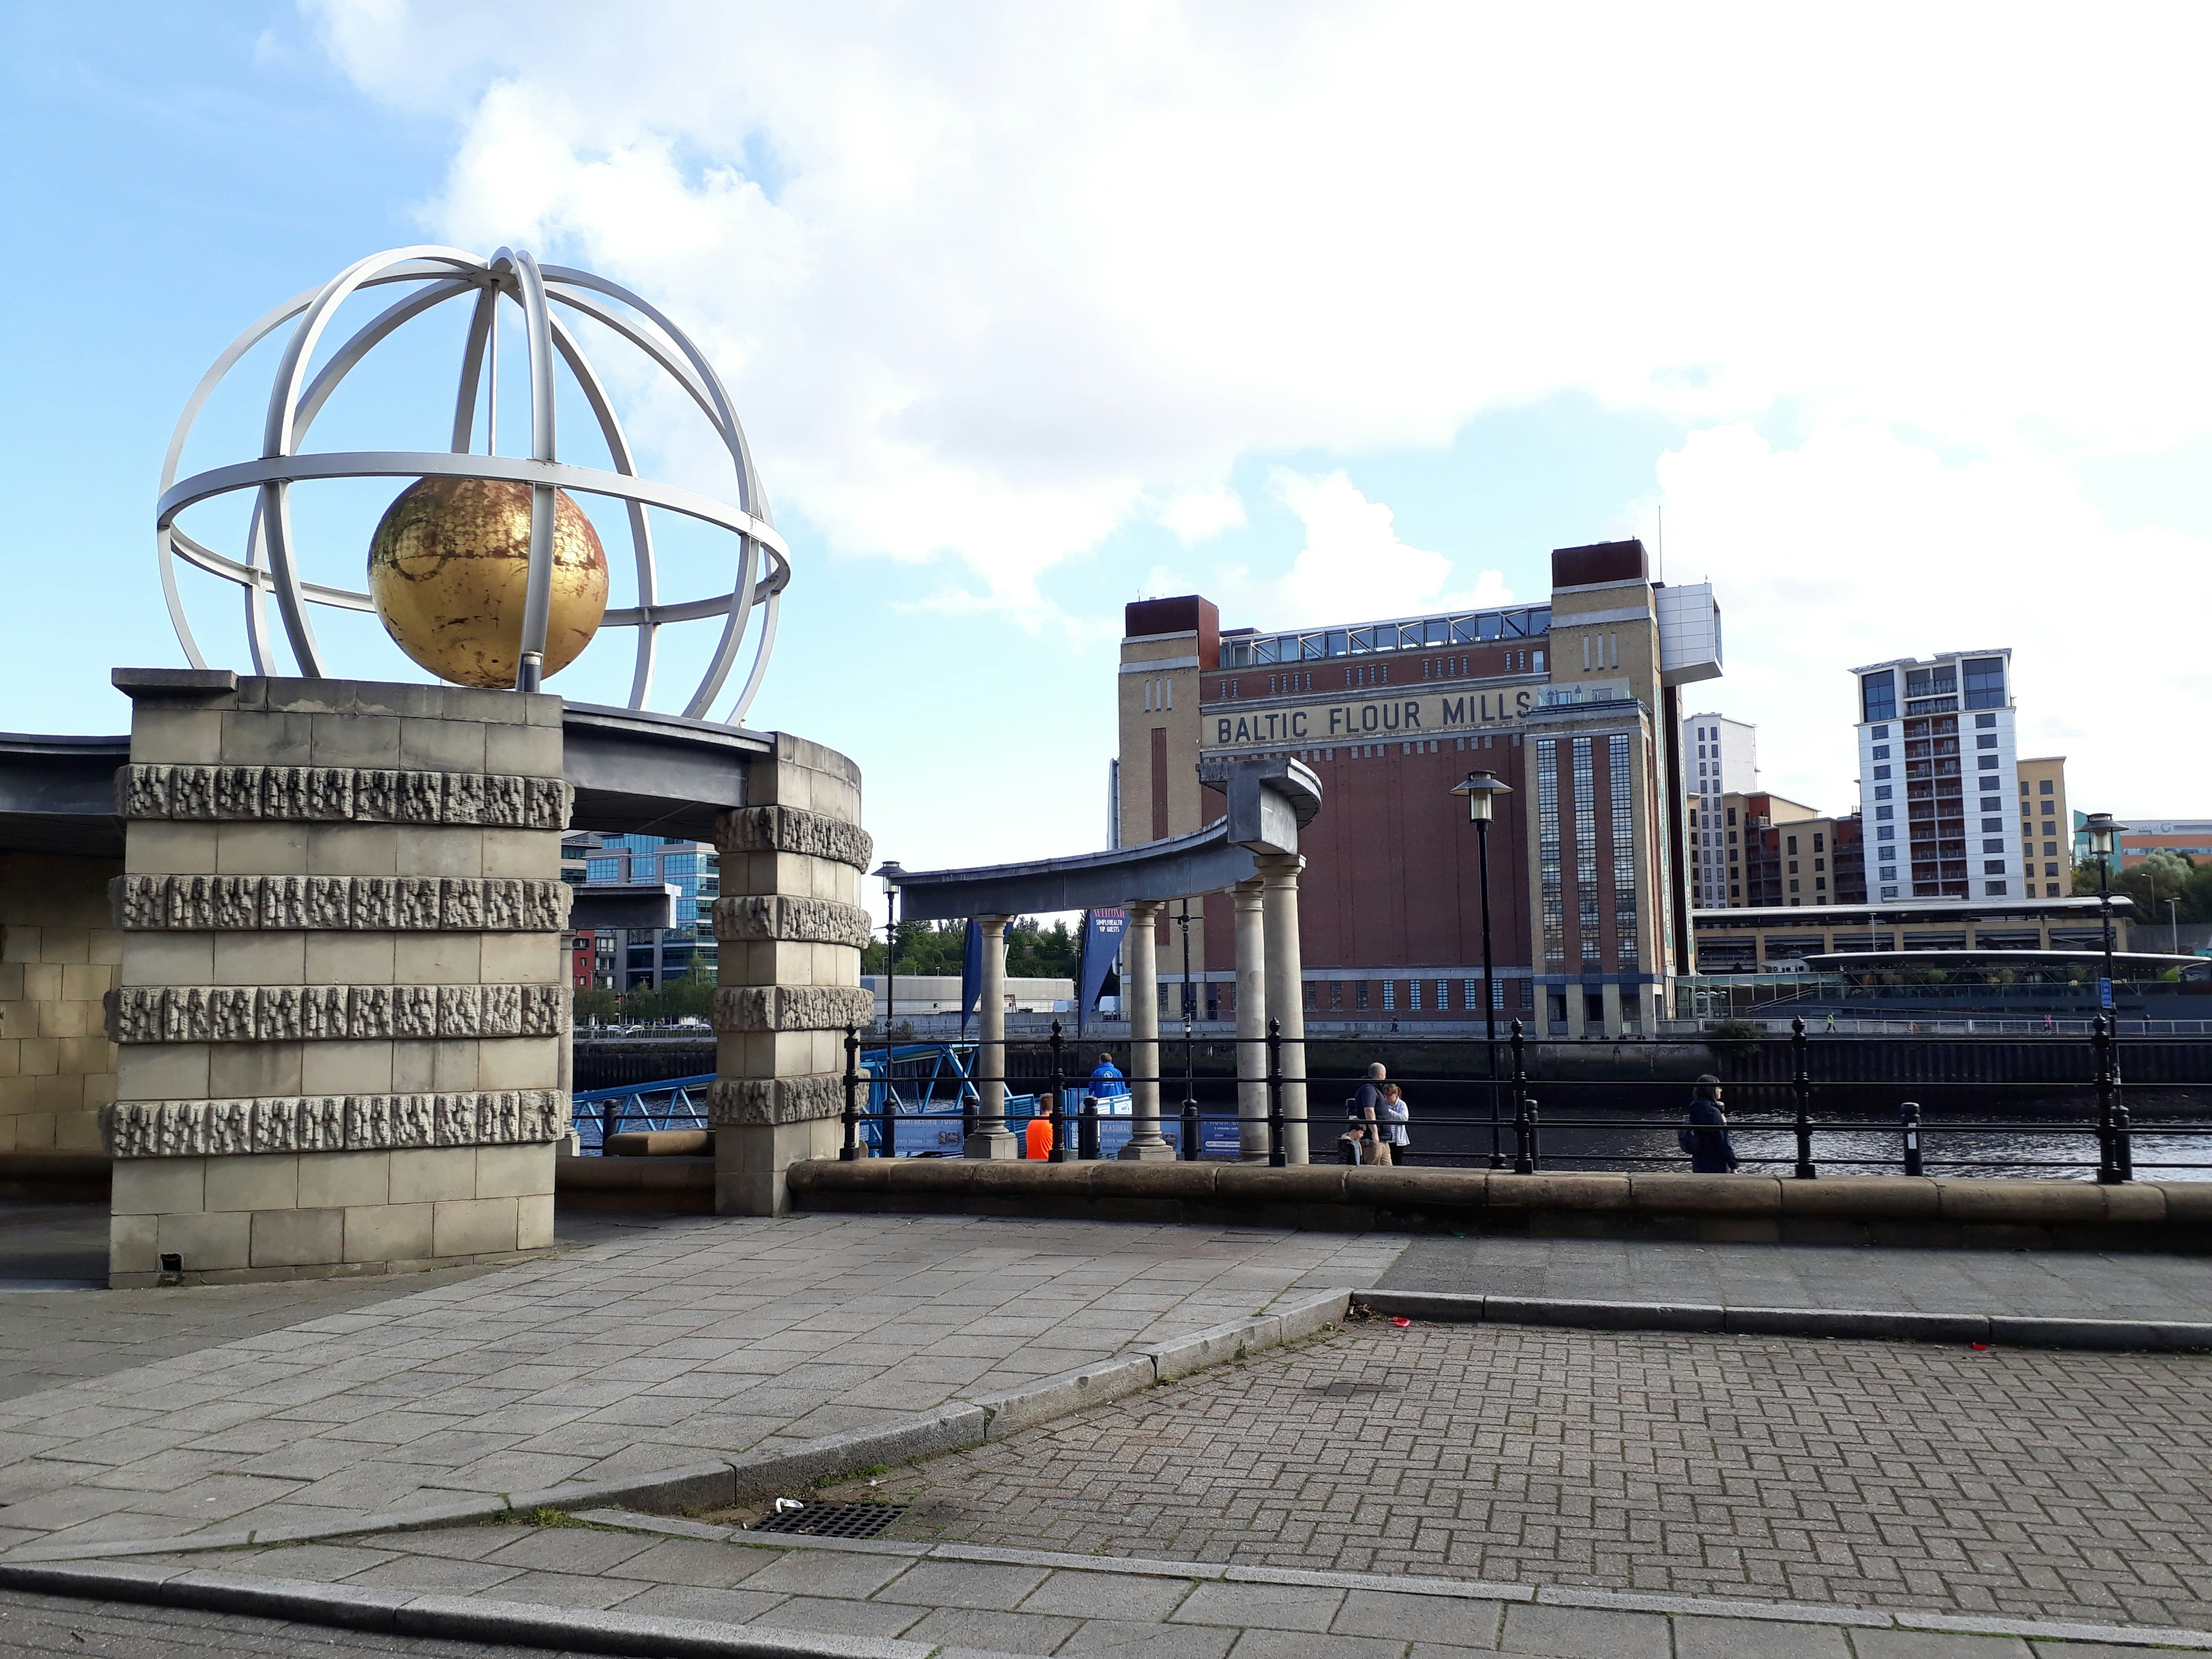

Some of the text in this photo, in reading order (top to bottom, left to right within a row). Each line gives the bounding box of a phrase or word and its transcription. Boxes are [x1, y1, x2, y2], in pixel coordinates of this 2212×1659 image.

[1218, 692, 1530, 744] BALTIC FLOUR MILLS
